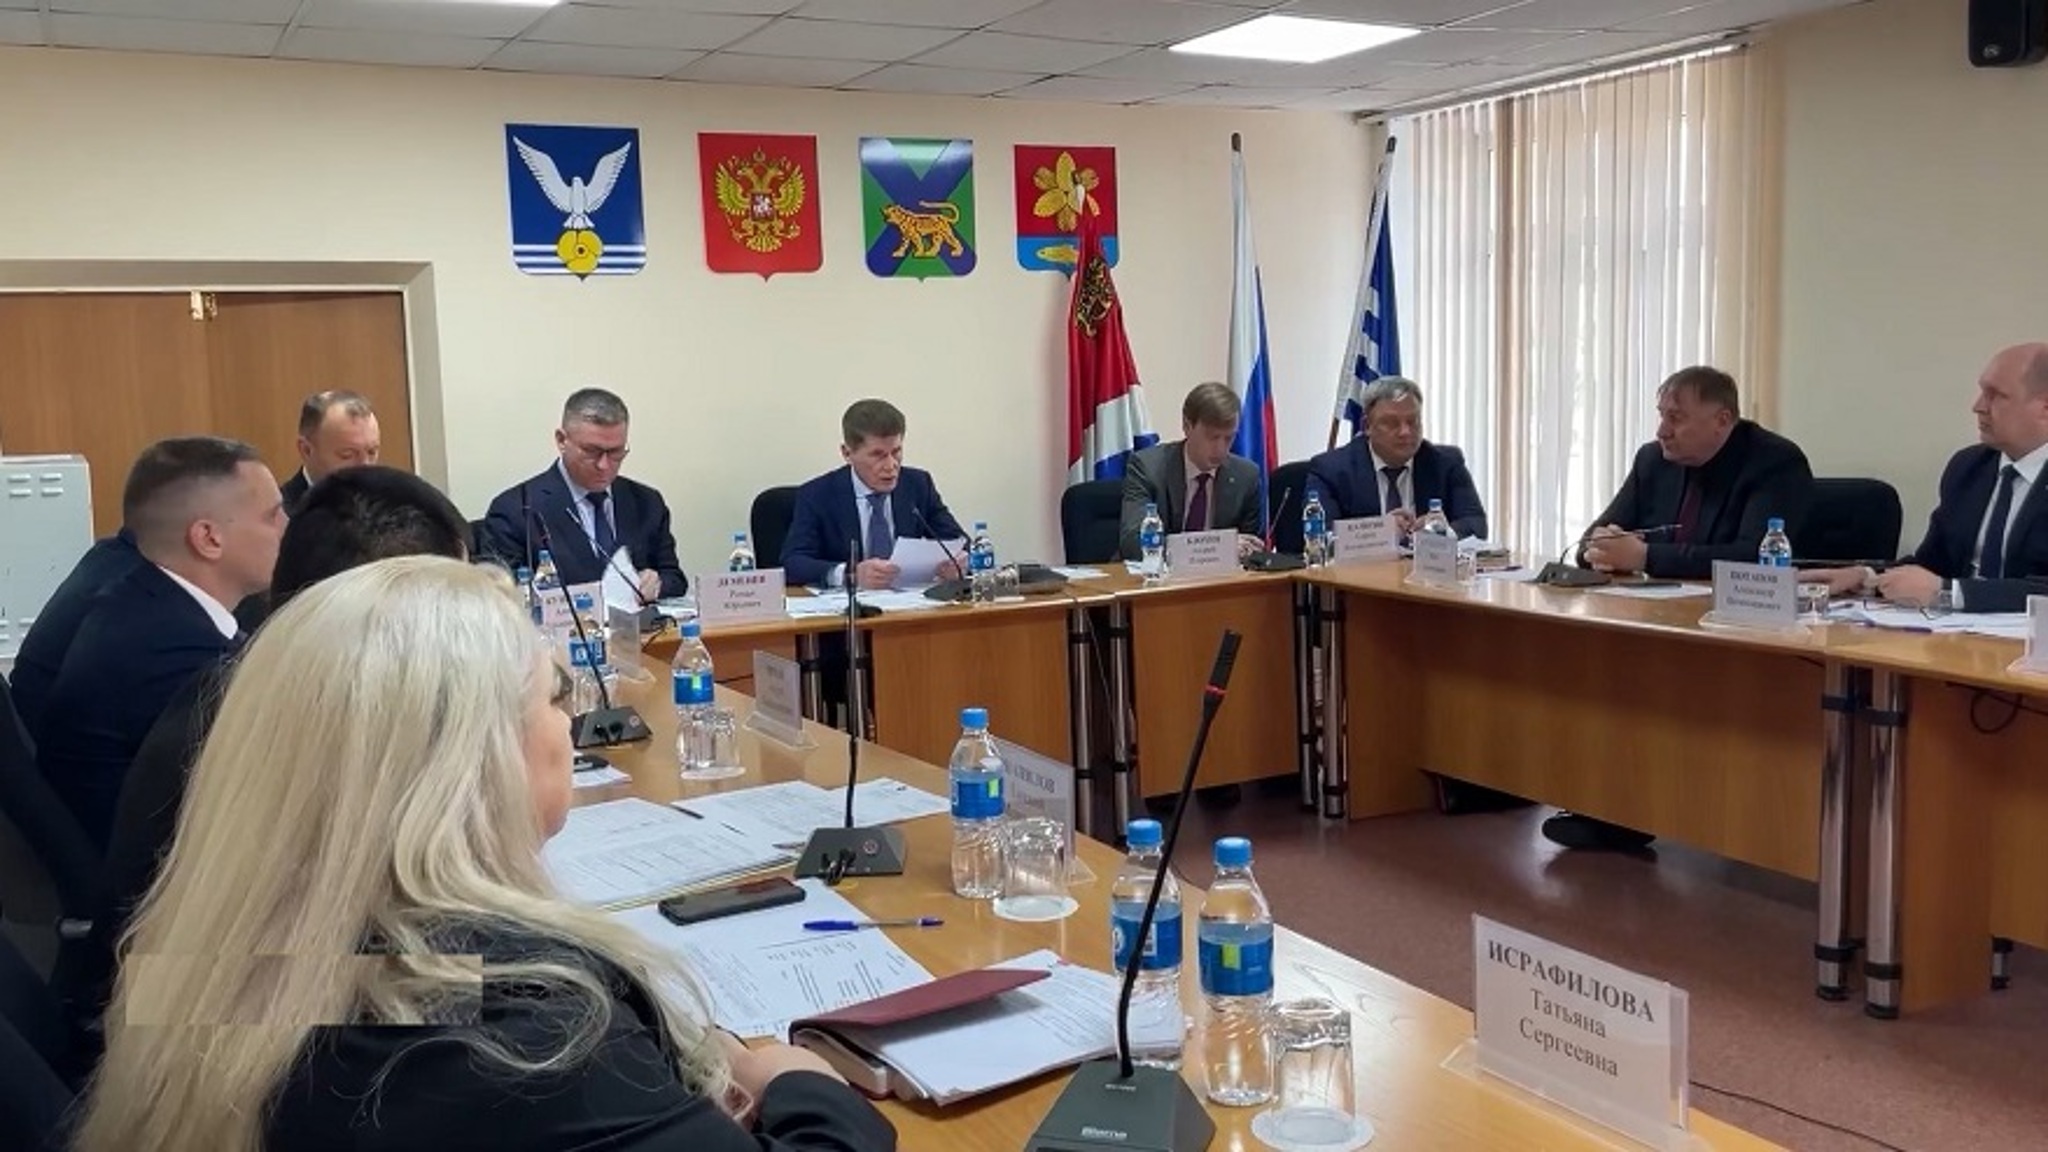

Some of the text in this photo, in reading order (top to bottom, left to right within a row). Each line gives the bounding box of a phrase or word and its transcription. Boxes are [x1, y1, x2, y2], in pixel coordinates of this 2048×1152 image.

[1487, 939, 1656, 1024] ИСРАФИЛОВА
[1530, 988, 1607, 1039] Татьяна
[1519, 1017, 1620, 1078] Сергеевна
